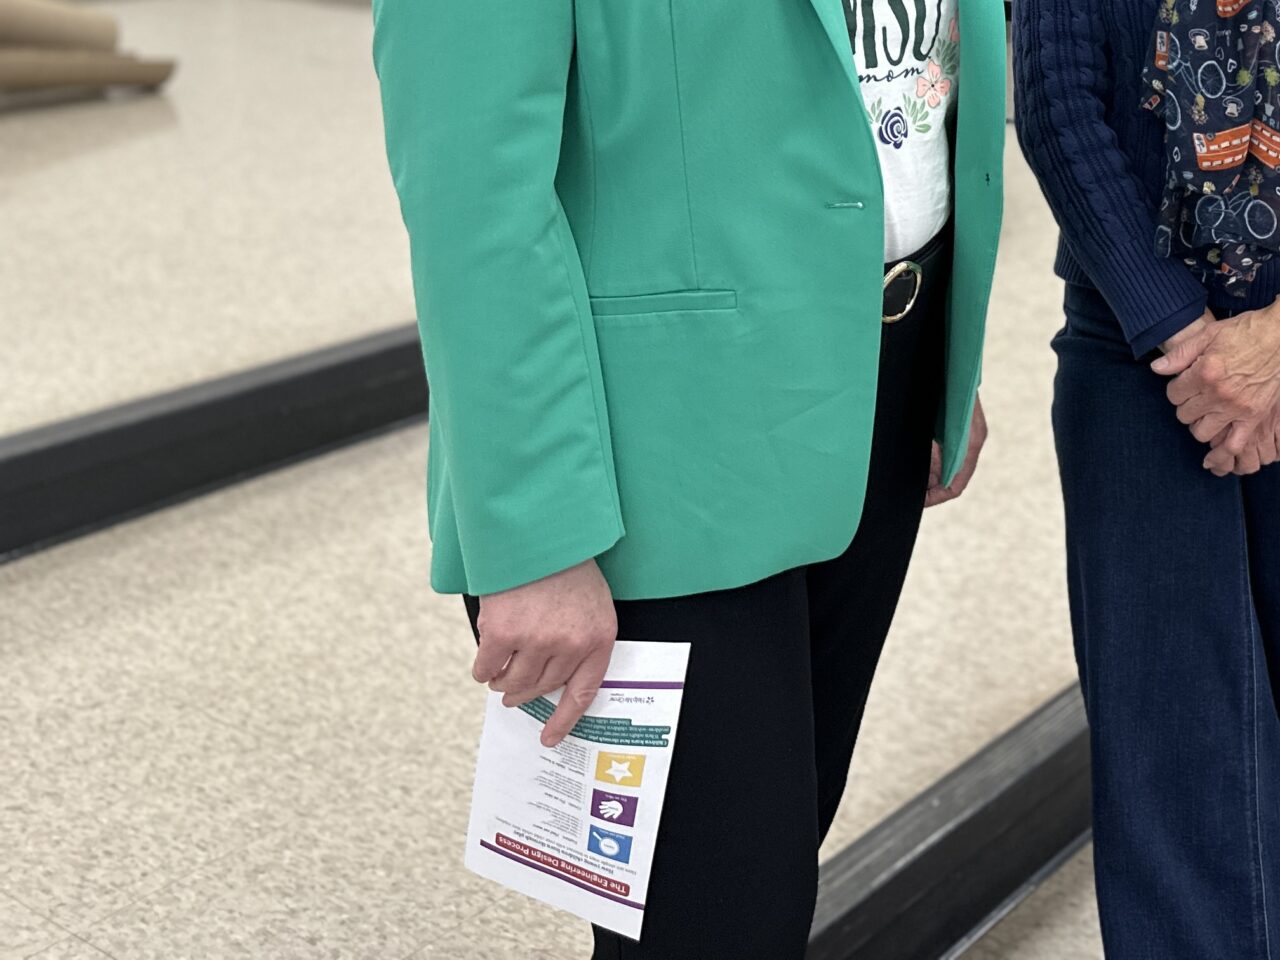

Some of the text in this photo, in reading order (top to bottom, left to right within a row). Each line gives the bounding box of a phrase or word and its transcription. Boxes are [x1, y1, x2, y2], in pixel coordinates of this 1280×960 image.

[858, 66, 925, 83] mom
[496, 835, 627, 893] The Engineering Design Process
